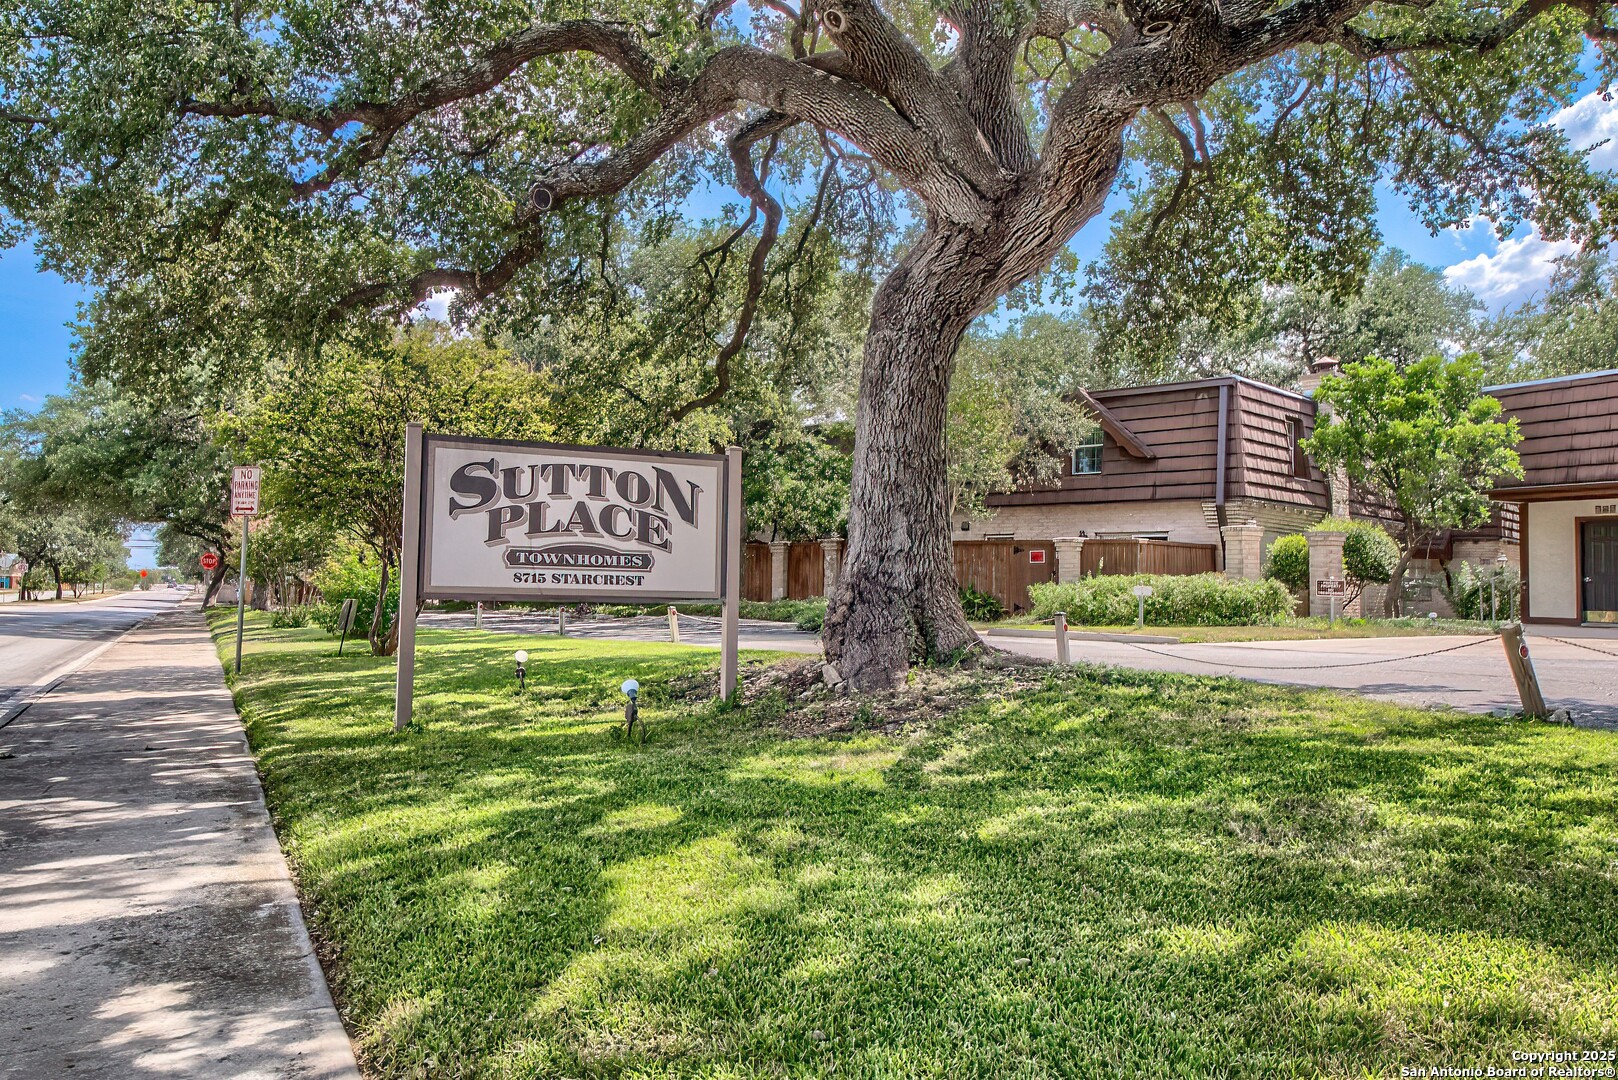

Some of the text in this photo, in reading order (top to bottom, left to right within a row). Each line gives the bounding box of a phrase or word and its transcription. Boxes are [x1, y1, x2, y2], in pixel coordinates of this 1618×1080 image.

[241, 470, 252, 479] NO
[235, 481, 258, 490] PARKING
[449, 457, 704, 529] SUTTON
[483, 500, 673, 554] PLACE
[516, 552, 643, 567] TOWNHOMES
[513, 572, 645, 586] 8715 STARCREST
